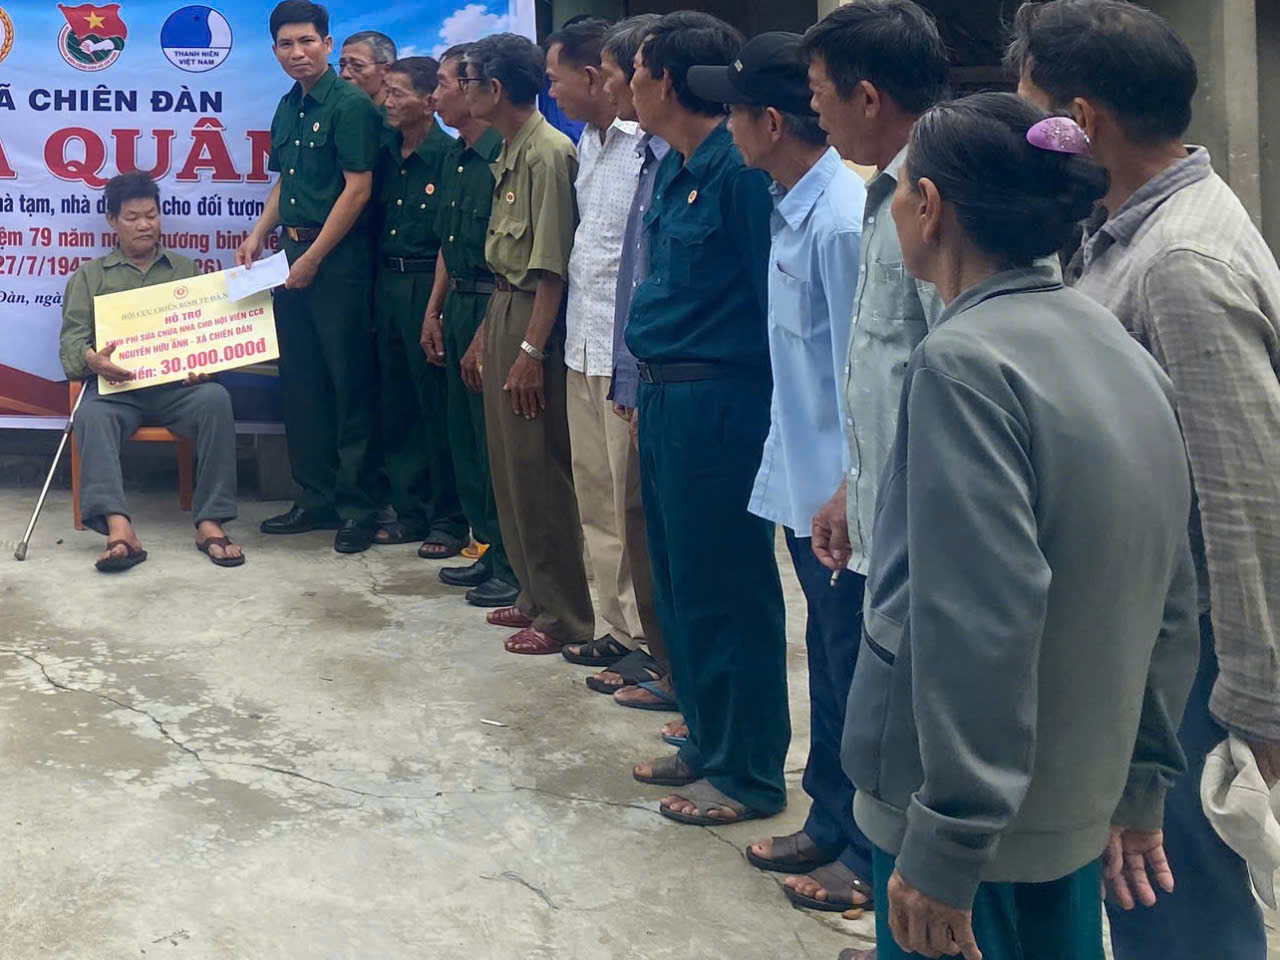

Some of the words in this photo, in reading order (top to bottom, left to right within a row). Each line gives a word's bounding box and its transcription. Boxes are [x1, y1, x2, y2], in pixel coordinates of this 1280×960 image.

[178, 58, 196, 66] VIỆT
[28, 85, 137, 112] CHIÊN
[150, 86, 222, 113] ĐÀN
[20, 195, 55, 217] tạm,
[61, 194, 91, 214] nhà
[162, 196, 191, 216] cho
[197, 193, 222, 216] đối
[227, 197, 265, 221] tượn
[29, 227, 52, 247] 79
[58, 228, 95, 248] năm
[34, 291, 63, 307] ngà
[164, 311, 179, 324] HỖ
[181, 308, 202, 321] TRỢ
[197, 319, 213, 330] CHO
[215, 316, 228, 326] HỘI
[229, 311, 247, 322] VIÊN
[248, 307, 264, 318] CCB
[119, 345, 152, 360] NGUYỄN
[209, 328, 234, 341] CHIÊN
[160, 337, 266, 376] 30.000.000đ
